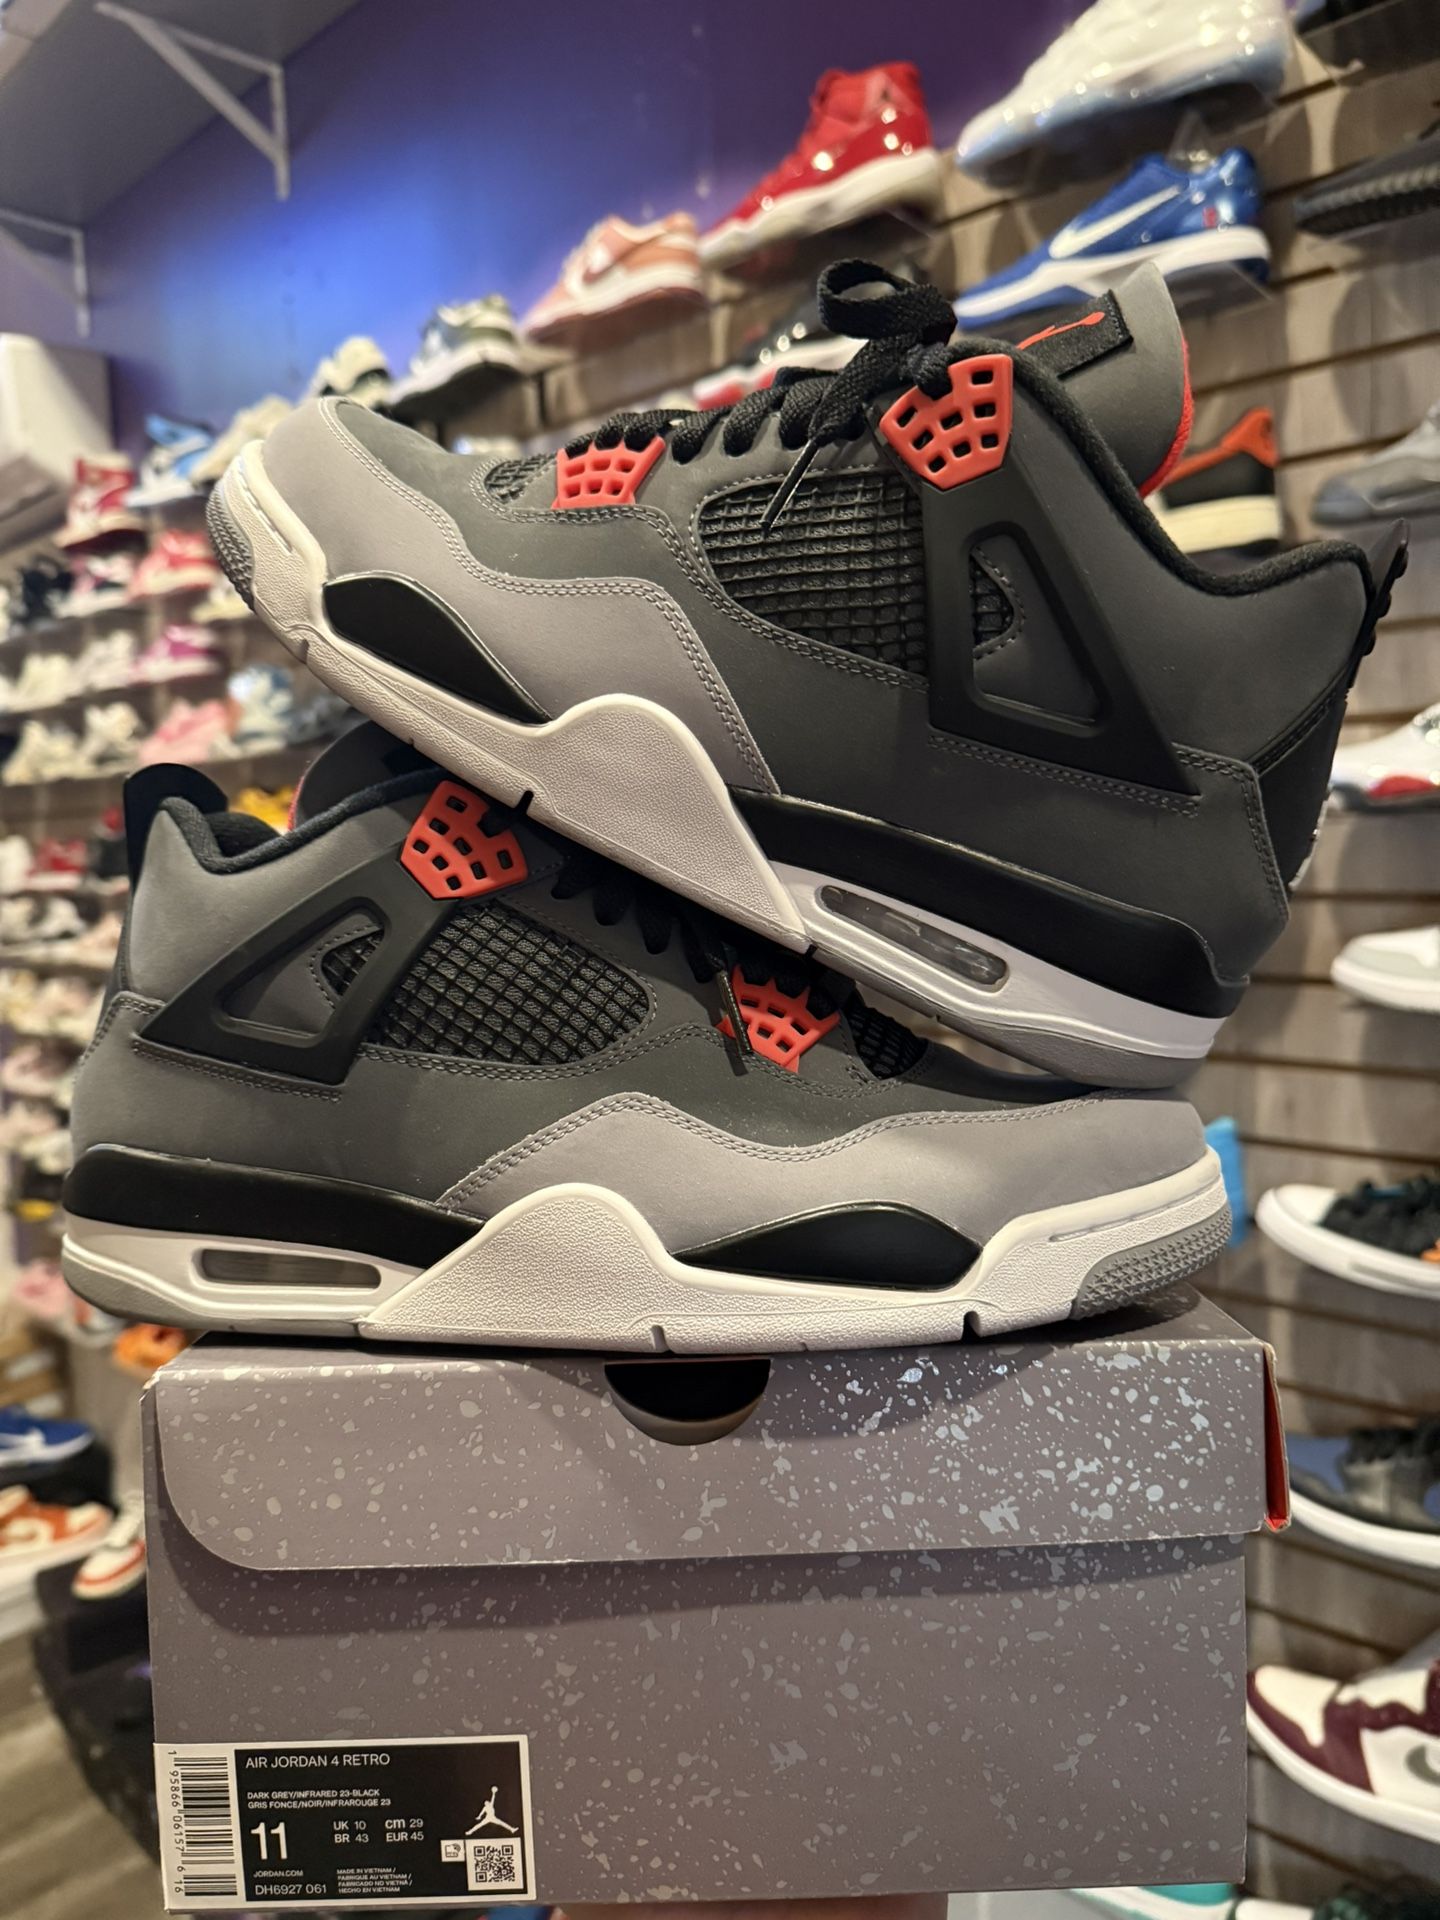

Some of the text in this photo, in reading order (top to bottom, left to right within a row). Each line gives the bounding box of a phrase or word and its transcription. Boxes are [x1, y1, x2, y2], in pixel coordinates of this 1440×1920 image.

[245, 1753, 390, 1768] AIR JORDAN 4 RETRO
[169, 1770, 181, 1808] 95866
[247, 1789, 380, 1800] DARK GREY/INFRARED 23-BLACK
[248, 1798, 391, 1809] GRIS FONCE/NOIR/INFRAROUGE 23
[333, 1820, 366, 1831] UK 10
[385, 1818, 424, 1829] cm 29
[173, 1815, 185, 1852] 06157
[335, 1833, 369, 1844] BR 43
[386, 1831, 424, 1842] EUR 45
[250, 1822, 288, 1860] 11
[253, 1870, 304, 1878] JORDAN.COM
[174, 1879, 184, 1894] 16
[255, 1884, 327, 1895] DH6927 061
